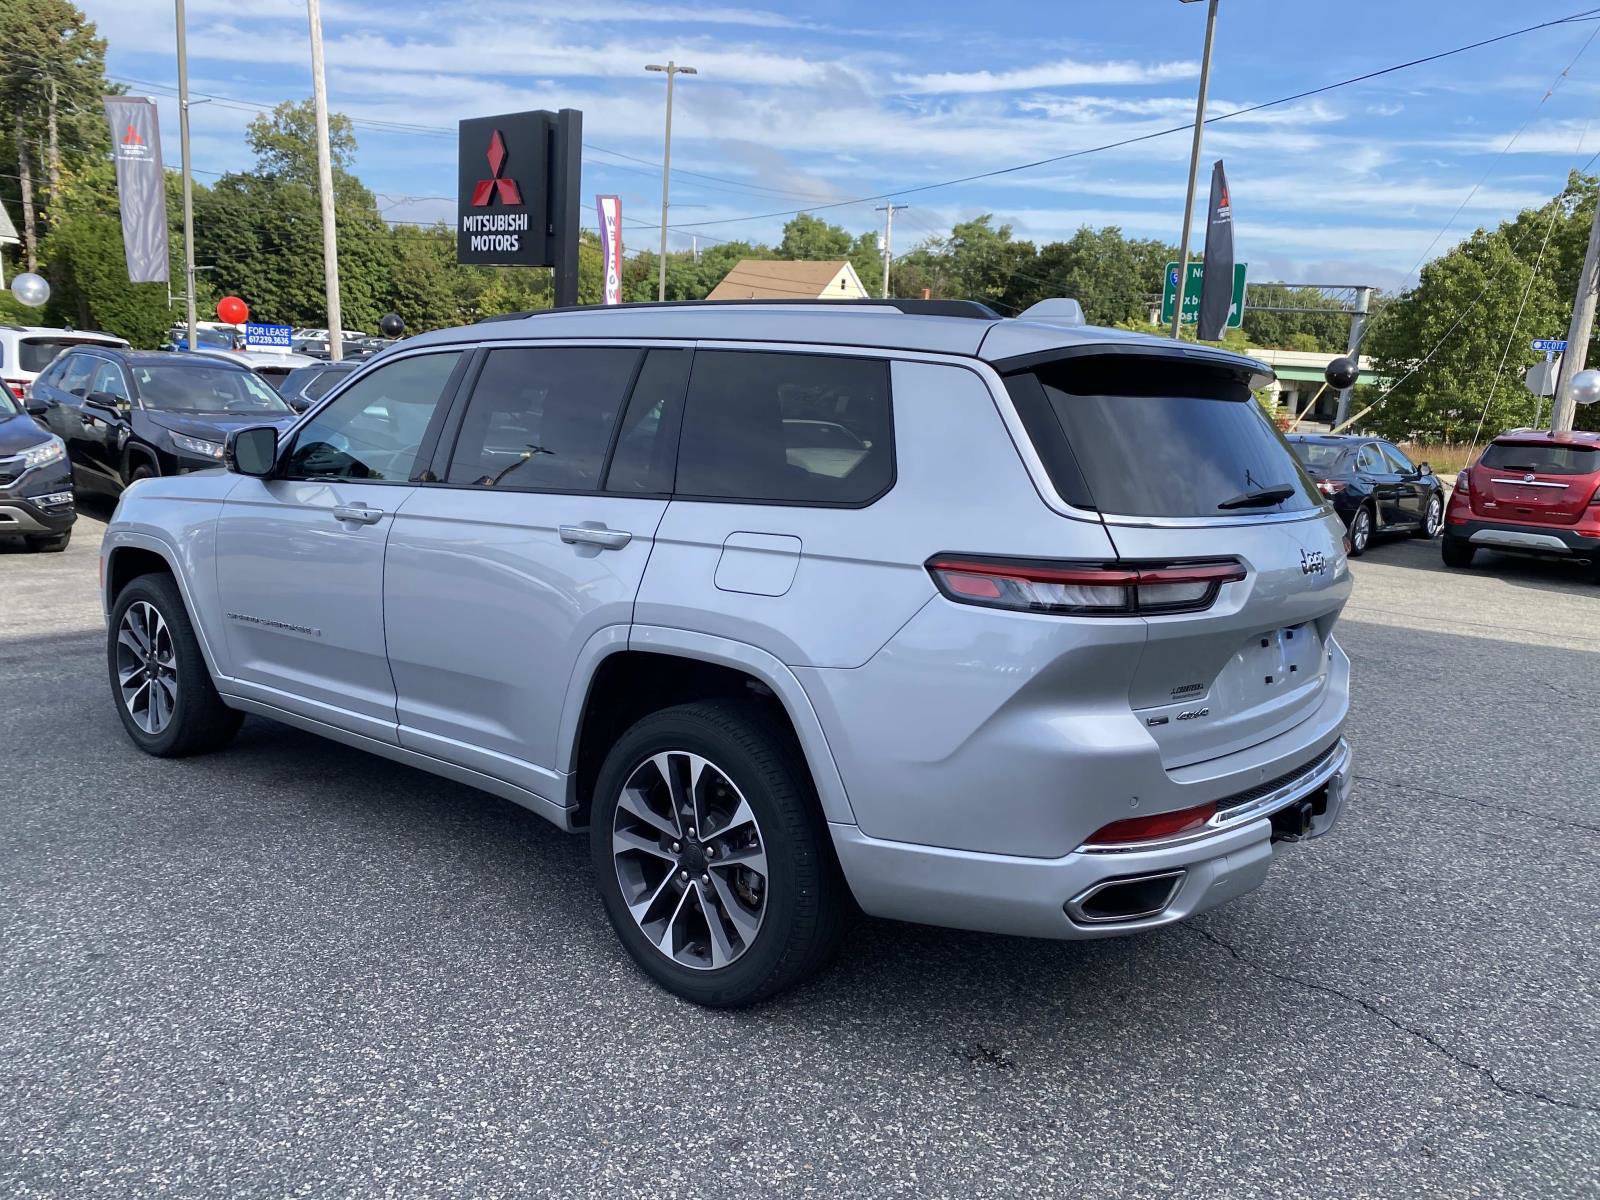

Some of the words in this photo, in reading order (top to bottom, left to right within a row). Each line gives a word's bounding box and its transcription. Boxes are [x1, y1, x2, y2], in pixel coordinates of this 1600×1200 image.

[463, 213, 528, 232] MITSUBISHI
[471, 234, 519, 252] MOTORS
[1192, 268, 1204, 278] N
[1169, 294, 1201, 306] Fxb
[248, 326, 264, 336] FOR
[265, 327, 290, 337] LEASE
[248, 335, 290, 345] 617.239.3636
[1542, 341, 1565, 350] SCOTT
[1299, 548, 1327, 576] Jeep
